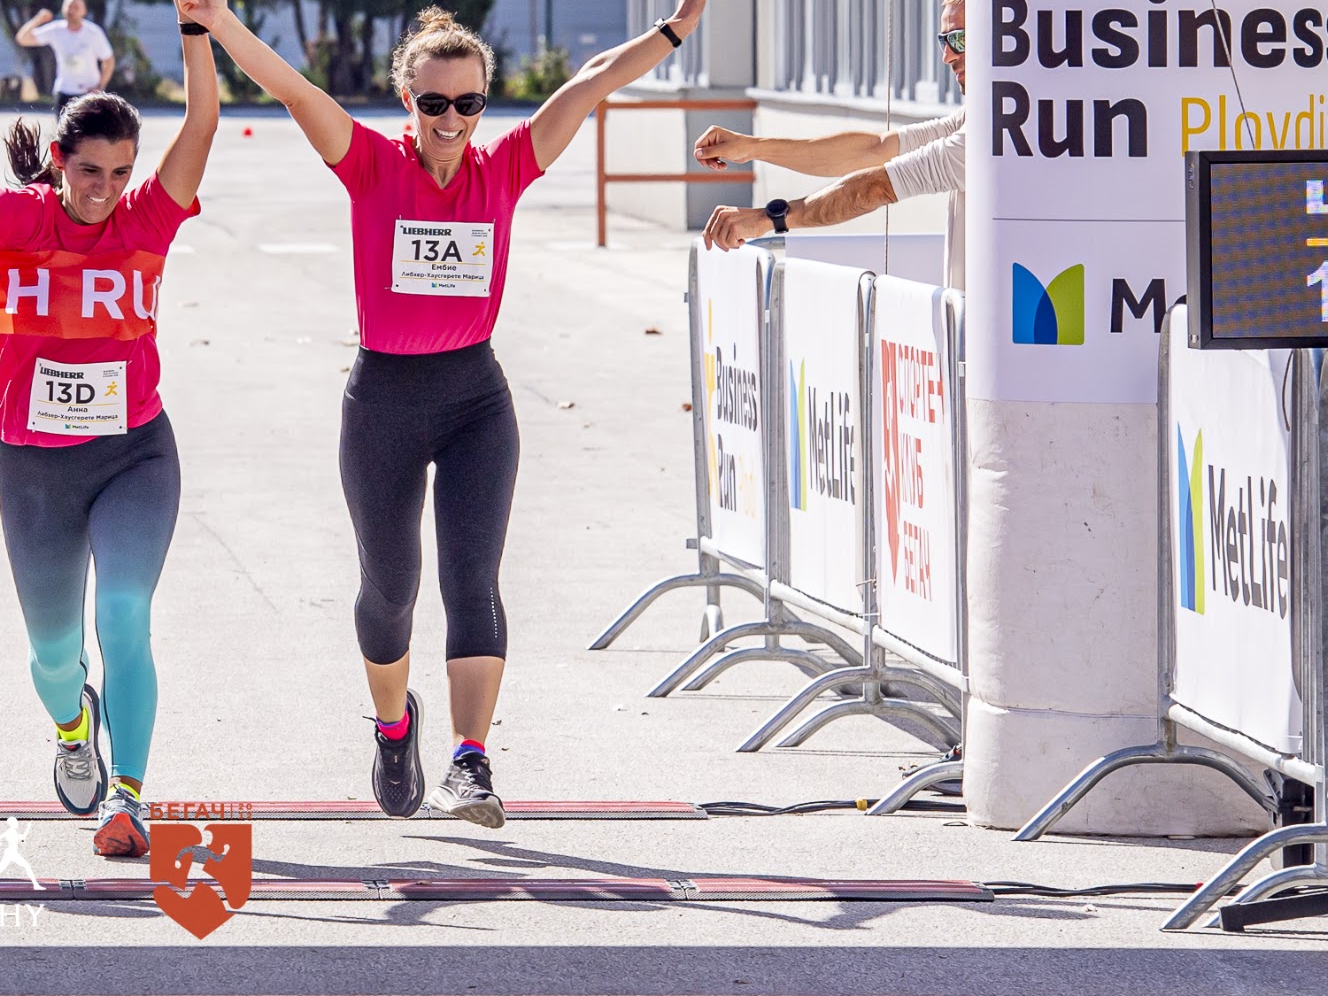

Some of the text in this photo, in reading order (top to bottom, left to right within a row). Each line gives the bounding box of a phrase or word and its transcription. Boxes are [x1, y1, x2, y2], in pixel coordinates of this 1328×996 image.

[991, 81, 1148, 158] Run
[402, 226, 452, 237] LIEBHERR
[411, 239, 463, 263] 13A
[39, 366, 85, 380] LIEBHERR
[45, 380, 96, 405] 13D
[716, 342, 758, 432] Business
[67, 405, 89, 413] Анна
[717, 433, 737, 512] Run
[1208, 464, 1288, 620] MetLife
